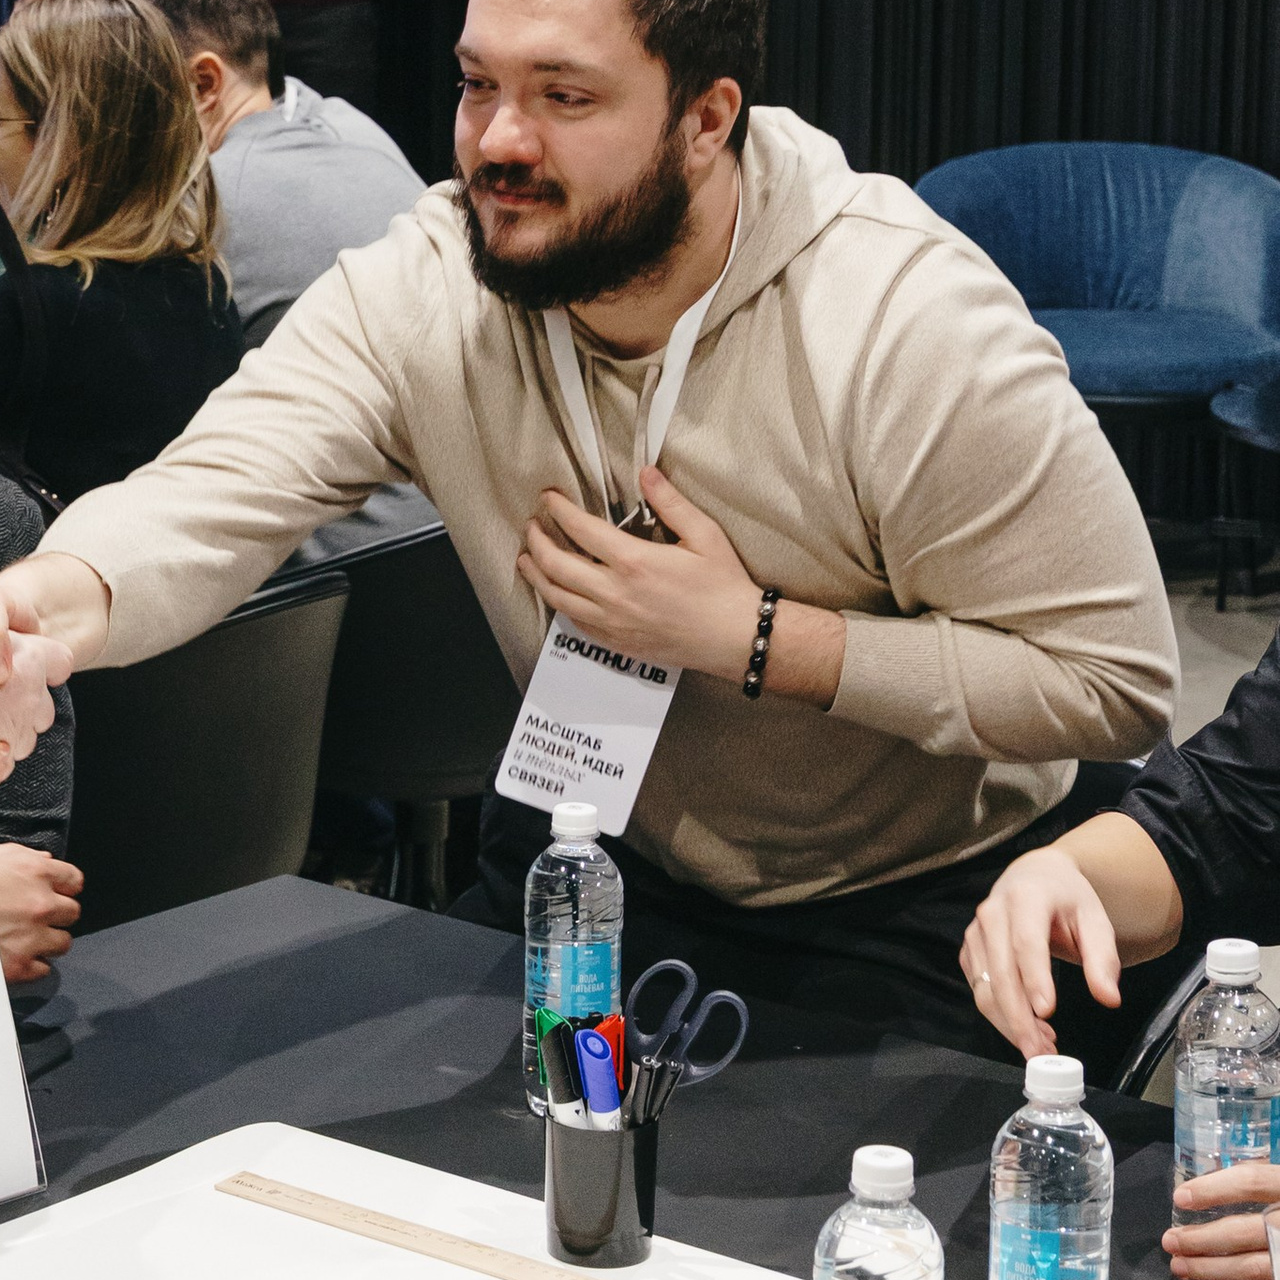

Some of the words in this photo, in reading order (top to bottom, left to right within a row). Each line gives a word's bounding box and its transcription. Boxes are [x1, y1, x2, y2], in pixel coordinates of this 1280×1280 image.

[525, 714, 603, 751] МАСШТАБ
[520, 732, 577, 764] ЛЮДЕЙ,
[583, 754, 625, 780] ИДЕЙ
[508, 765, 565, 796] СВЯЗЕЙ
[570, 982, 605, 993] ПИТЬЕВАЯ
[579, 973, 598, 983] ВОДА
[1014, 1261, 1036, 1276] ВОДА
